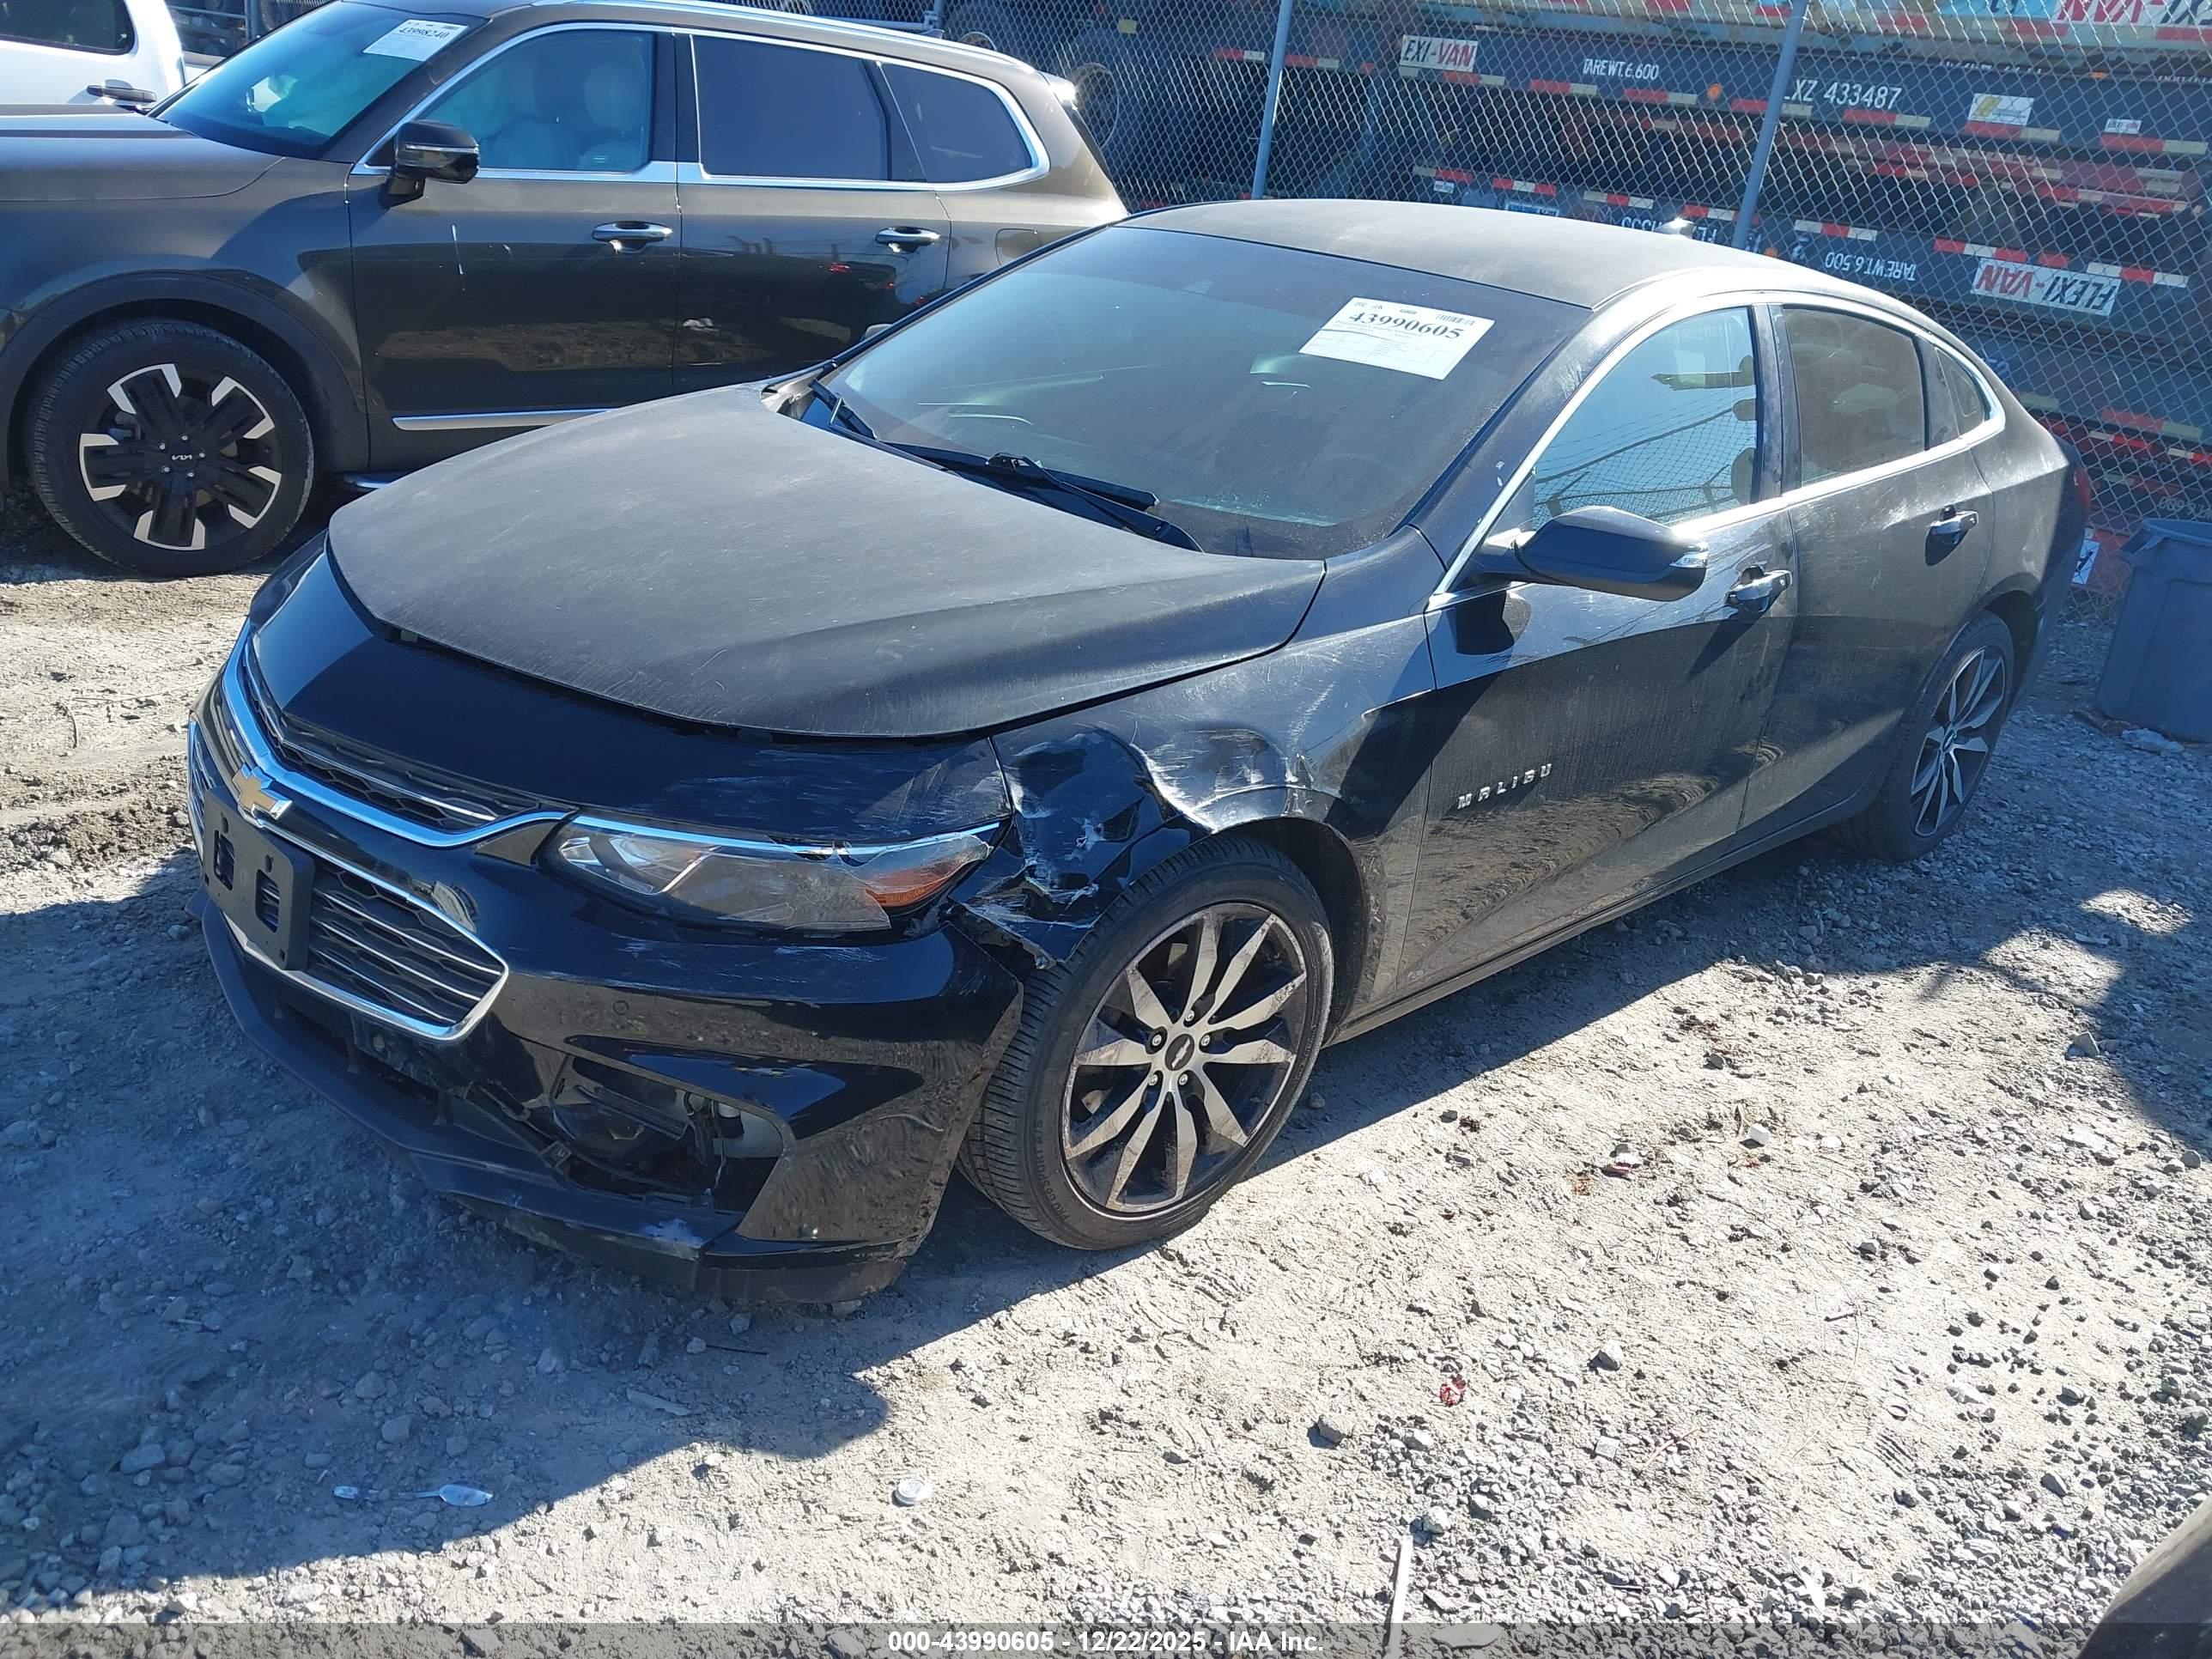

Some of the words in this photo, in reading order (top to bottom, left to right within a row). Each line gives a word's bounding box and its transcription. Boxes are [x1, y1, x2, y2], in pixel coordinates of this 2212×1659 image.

[1824, 82, 1903, 110] 433487
[1349, 312, 1464, 340] 43990605
[1457, 763, 1553, 810] MALIBU
